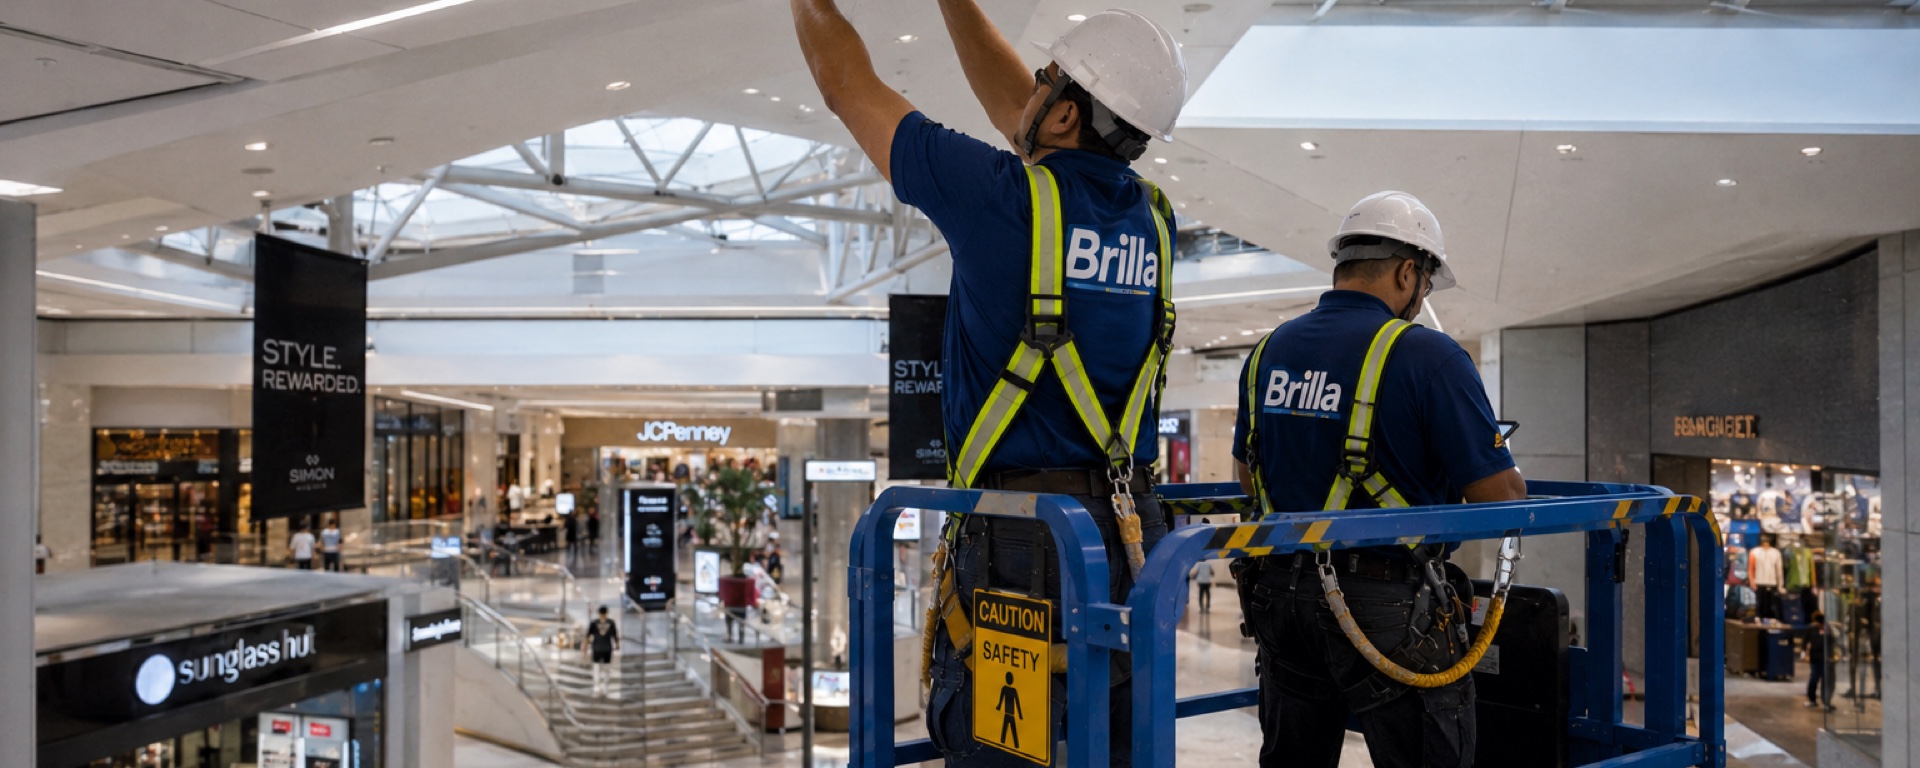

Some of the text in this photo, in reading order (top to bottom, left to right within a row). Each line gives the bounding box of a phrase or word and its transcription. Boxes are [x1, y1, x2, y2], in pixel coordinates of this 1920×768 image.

[1065, 228, 1158, 288] Brilla
[262, 338, 342, 370] STYLE.
[262, 369, 361, 394] REWARDED.
[894, 360, 943, 378] STYL
[894, 380, 943, 394] REWAR
[1264, 369, 1342, 412] Brilla
[636, 420, 732, 446] JCPenney
[915, 448, 946, 459] SIMO
[289, 467, 335, 483] SIMON
[979, 600, 1045, 634] CAUTION
[179, 625, 317, 684] sunglass hut
[983, 640, 1040, 672] SAFETY
